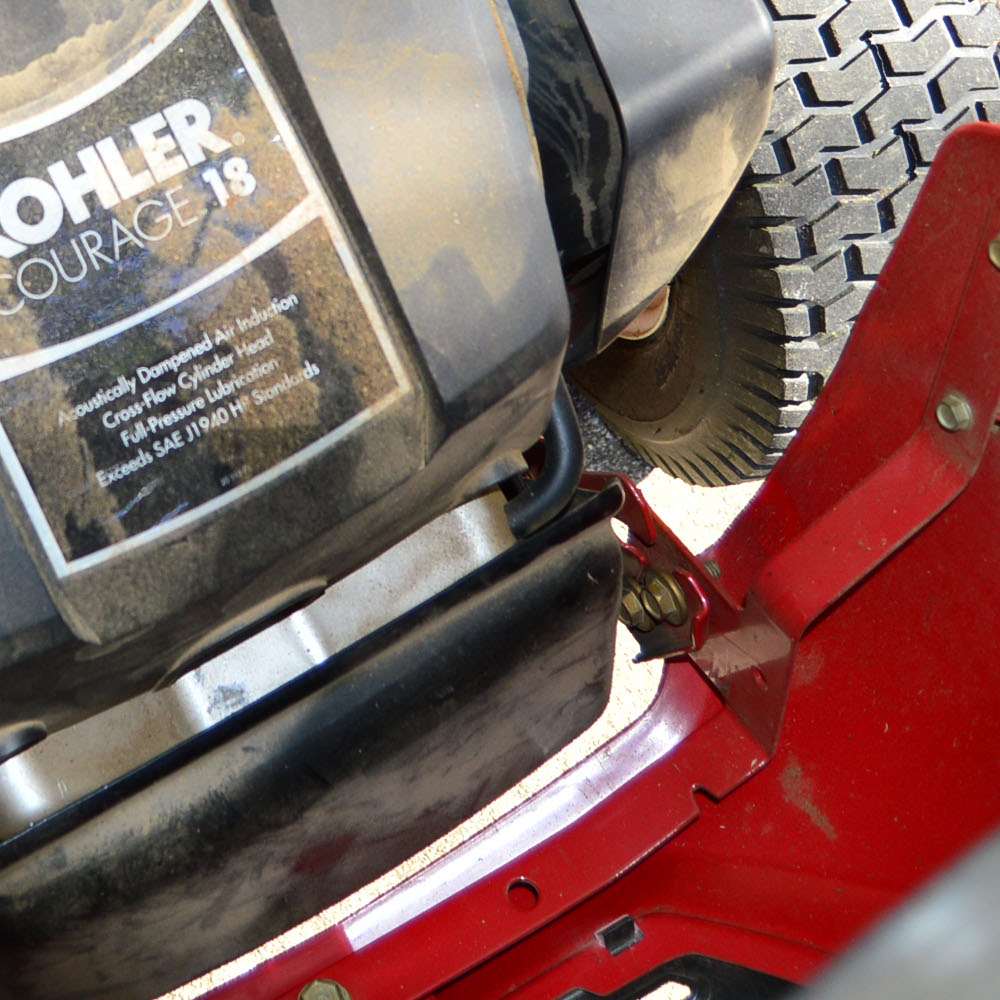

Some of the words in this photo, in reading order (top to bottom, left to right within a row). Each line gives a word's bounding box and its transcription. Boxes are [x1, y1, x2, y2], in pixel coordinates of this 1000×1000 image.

[201, 157, 257, 208] 18
[58, 374, 137, 428] Acoustically
[136, 331, 213, 385] Dampened
[214, 324, 236, 346] Air
[235, 293, 299, 333] Induction
[102, 383, 177, 429] Cross-Flow
[177, 352, 235, 391] Cylinder
[235, 327, 275, 359] Head
[119, 397, 206, 448] Full-Pressure
[204, 357, 280, 404] Lubrication
[96, 447, 154, 488] Exceeds
[152, 430, 186, 459] SAE
[184, 406, 230, 443] J1940
